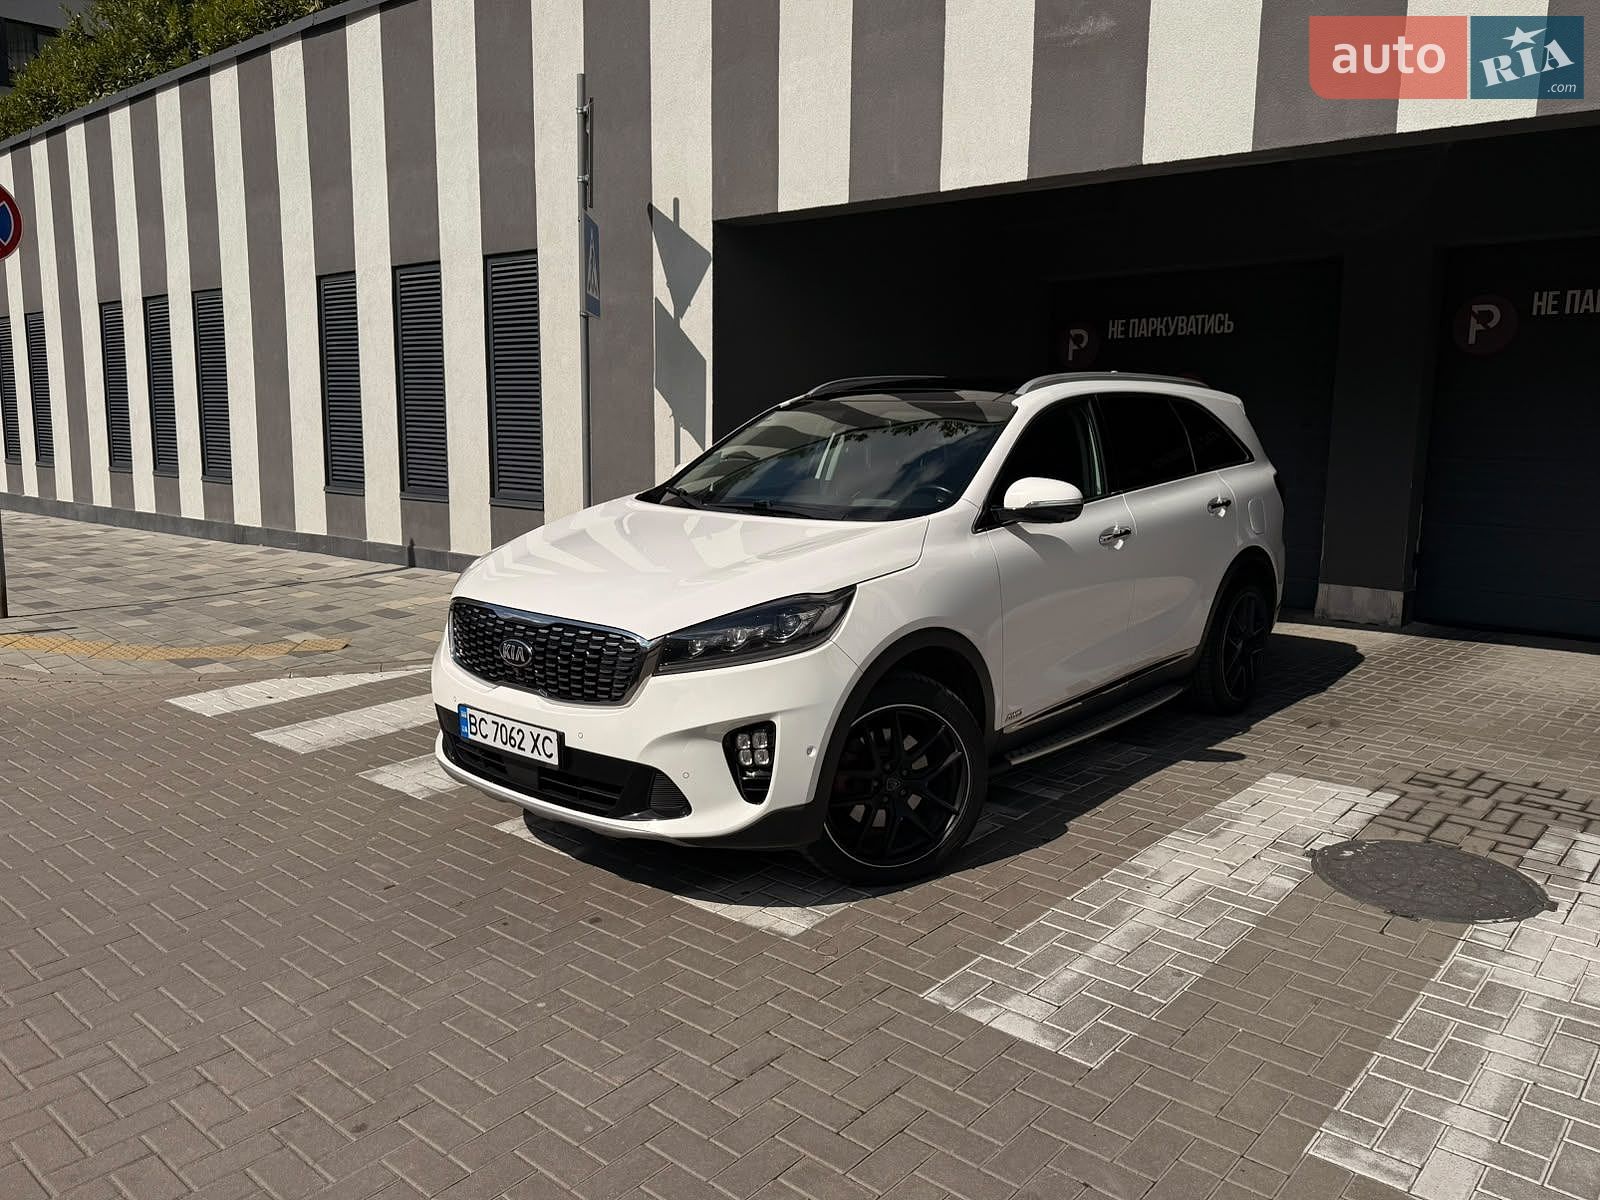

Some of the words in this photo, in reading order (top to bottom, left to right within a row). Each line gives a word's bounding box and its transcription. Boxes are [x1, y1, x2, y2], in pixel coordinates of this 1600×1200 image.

[1532, 290, 1561, 316] НЕ
[1565, 288, 1600, 315] ПА
[1108, 319, 1126, 340] НЕ
[1128, 313, 1235, 338] ПАРКУВАТИСЬ
[502, 643, 526, 662] KIA
[468, 713, 488, 739] BC
[492, 720, 526, 752] 7062
[529, 731, 554, 759] XC
